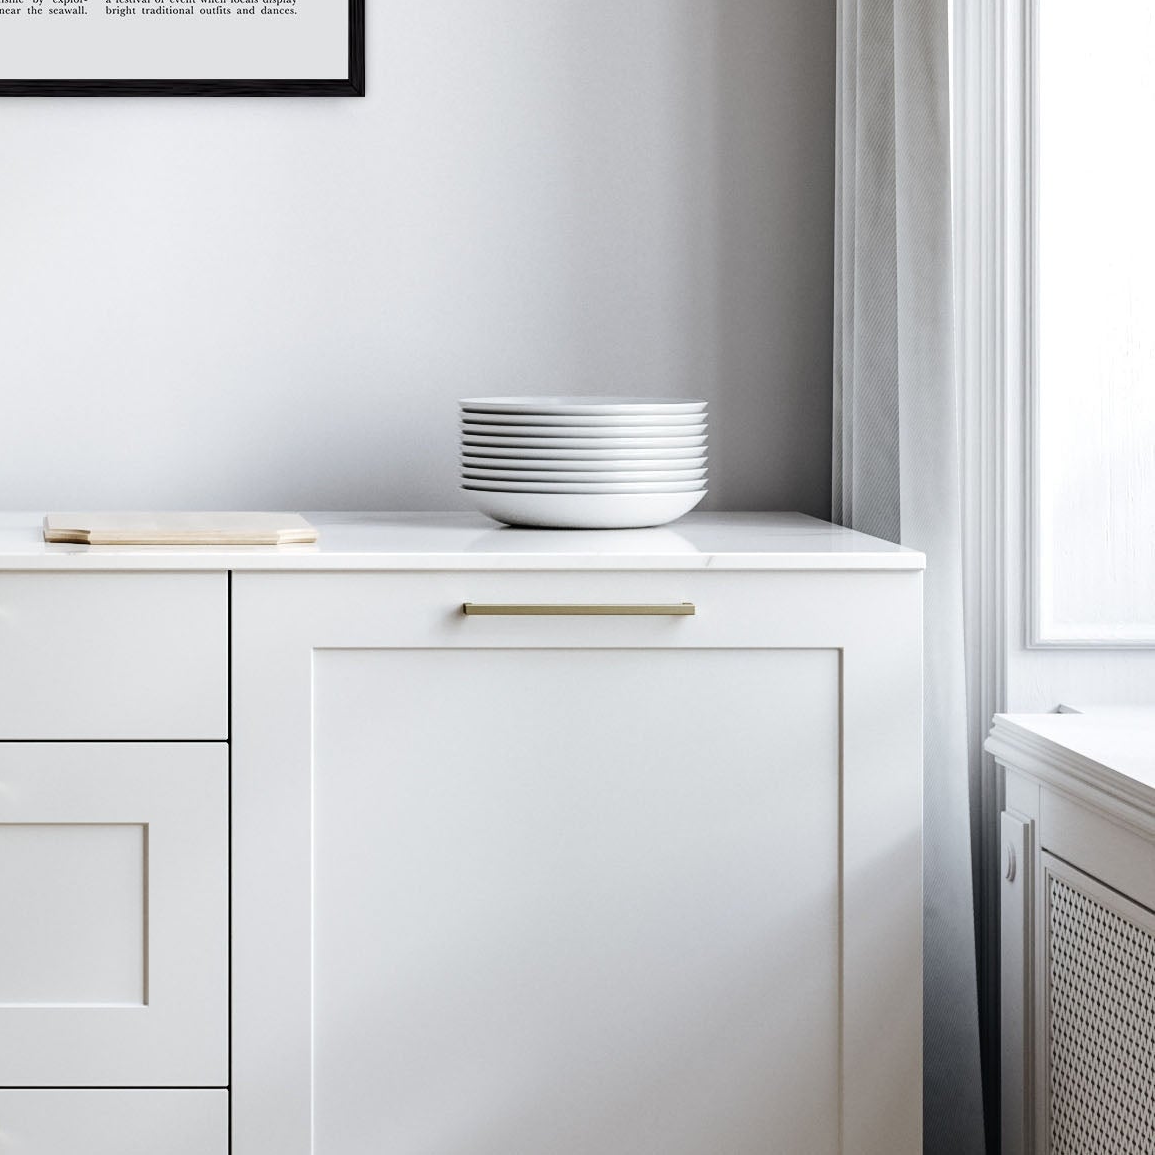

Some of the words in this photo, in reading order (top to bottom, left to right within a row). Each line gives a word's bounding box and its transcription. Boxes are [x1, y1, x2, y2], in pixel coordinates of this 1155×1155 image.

[27, 6, 43, 15] the
[49, 6, 87, 15] seawall.
[105, 6, 136, 17] bright
[142, 6, 194, 15] traditional
[199, 6, 231, 15] outfits
[237, 6, 255, 15] and
[261, 6, 297, 15] dances.
